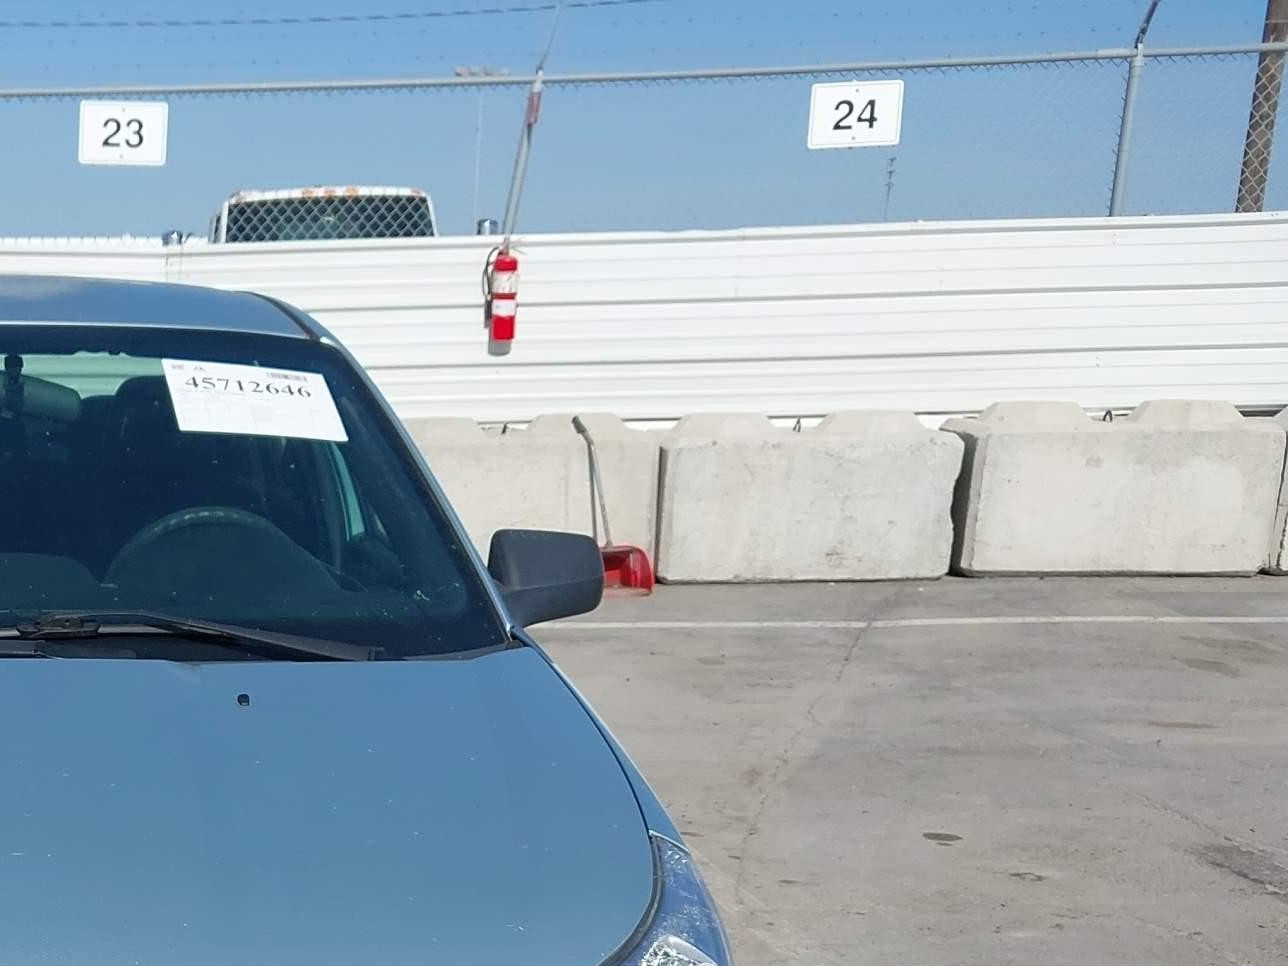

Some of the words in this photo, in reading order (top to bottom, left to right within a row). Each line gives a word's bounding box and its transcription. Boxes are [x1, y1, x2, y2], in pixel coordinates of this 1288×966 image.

[832, 99, 878, 130] 24
[102, 118, 144, 148] 23
[184, 375, 312, 398] 45712646
